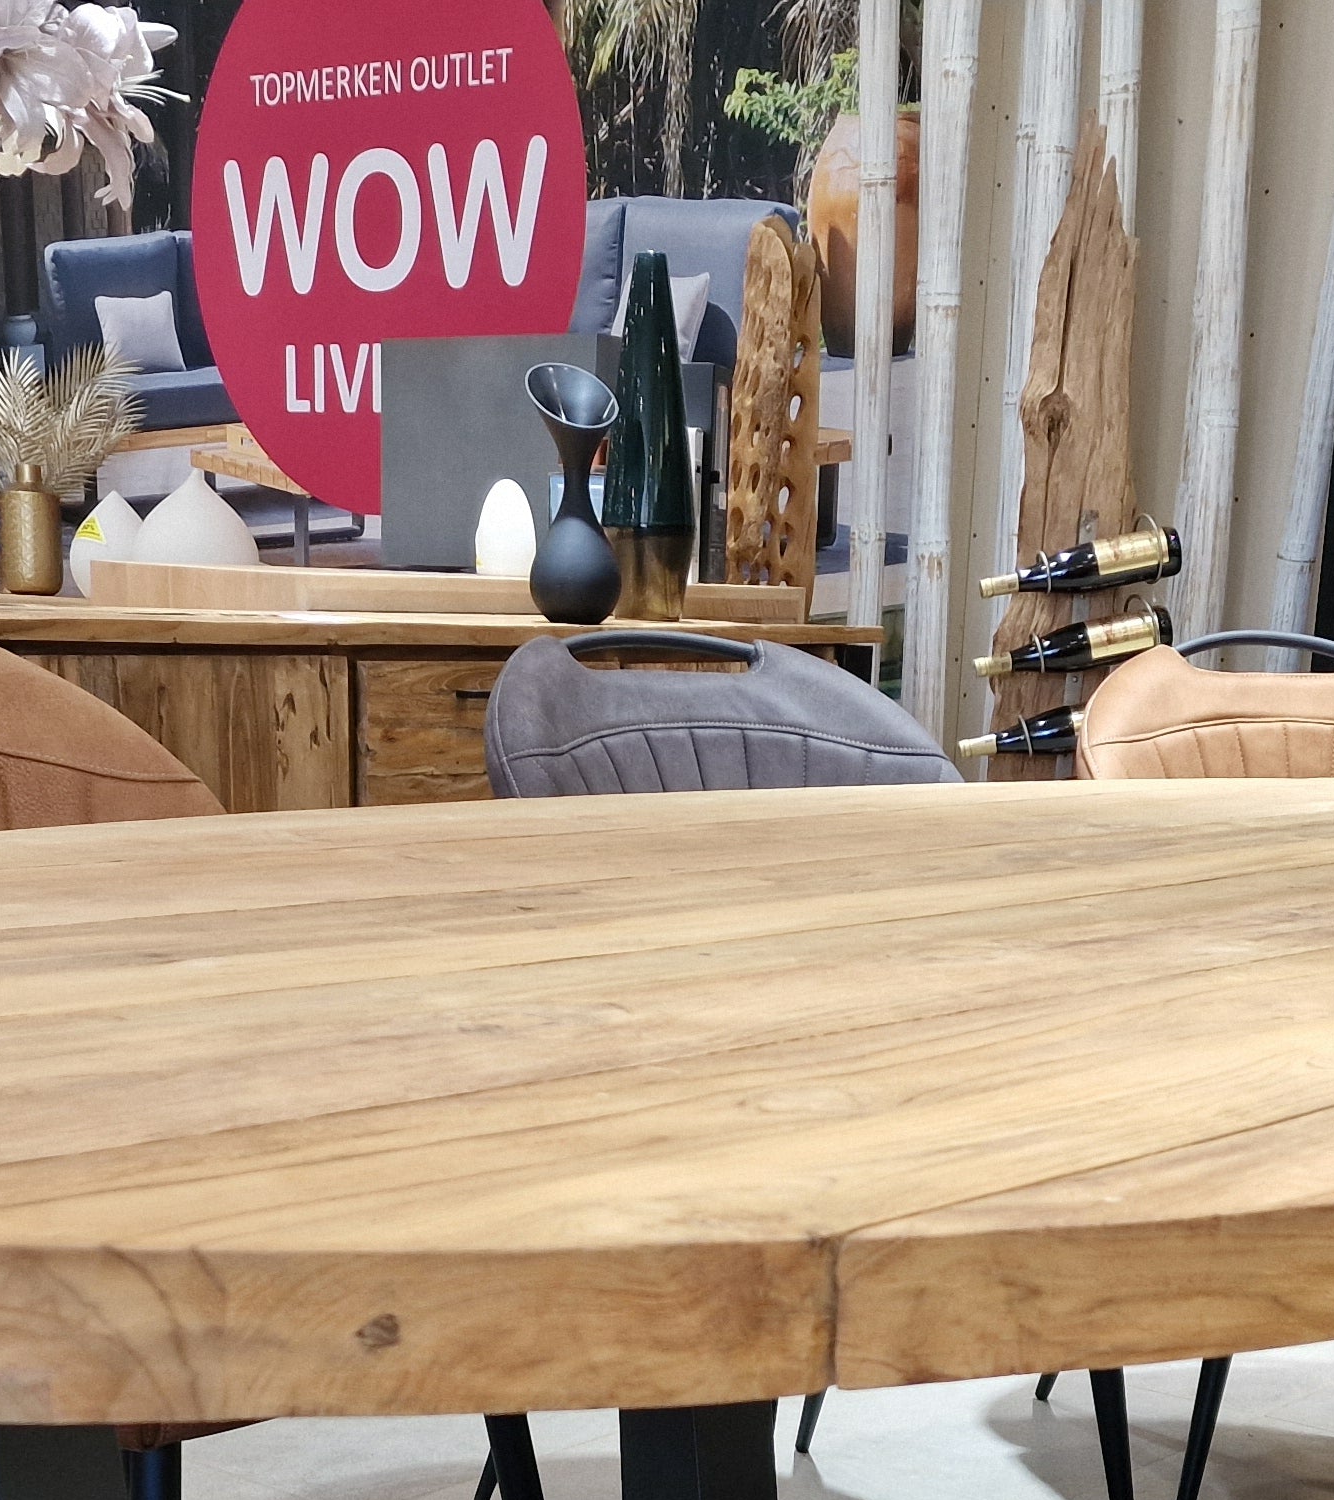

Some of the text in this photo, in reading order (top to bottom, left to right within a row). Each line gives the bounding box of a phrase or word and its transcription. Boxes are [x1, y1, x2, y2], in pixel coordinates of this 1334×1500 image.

[249, 47, 513, 107] TOPMERKEN OUTLET
[223, 134, 548, 297] WOW
[285, 342, 382, 414] LIVI
